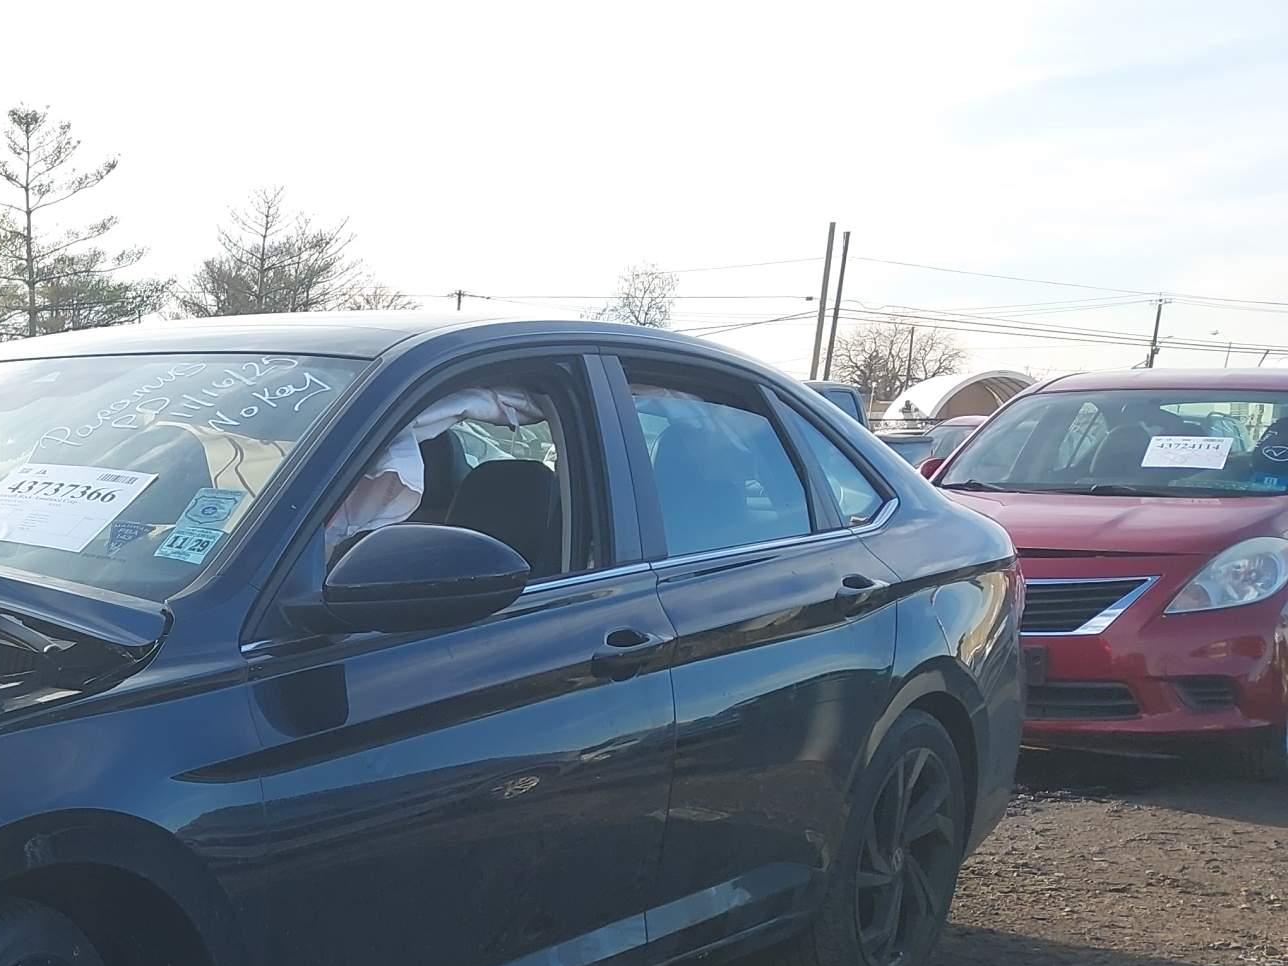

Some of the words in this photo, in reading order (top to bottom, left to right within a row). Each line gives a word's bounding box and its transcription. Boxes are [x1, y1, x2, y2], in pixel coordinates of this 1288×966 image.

[7, 479, 123, 504] 43737366
[166, 535, 190, 549] 11
[187, 538, 211, 552] 29
